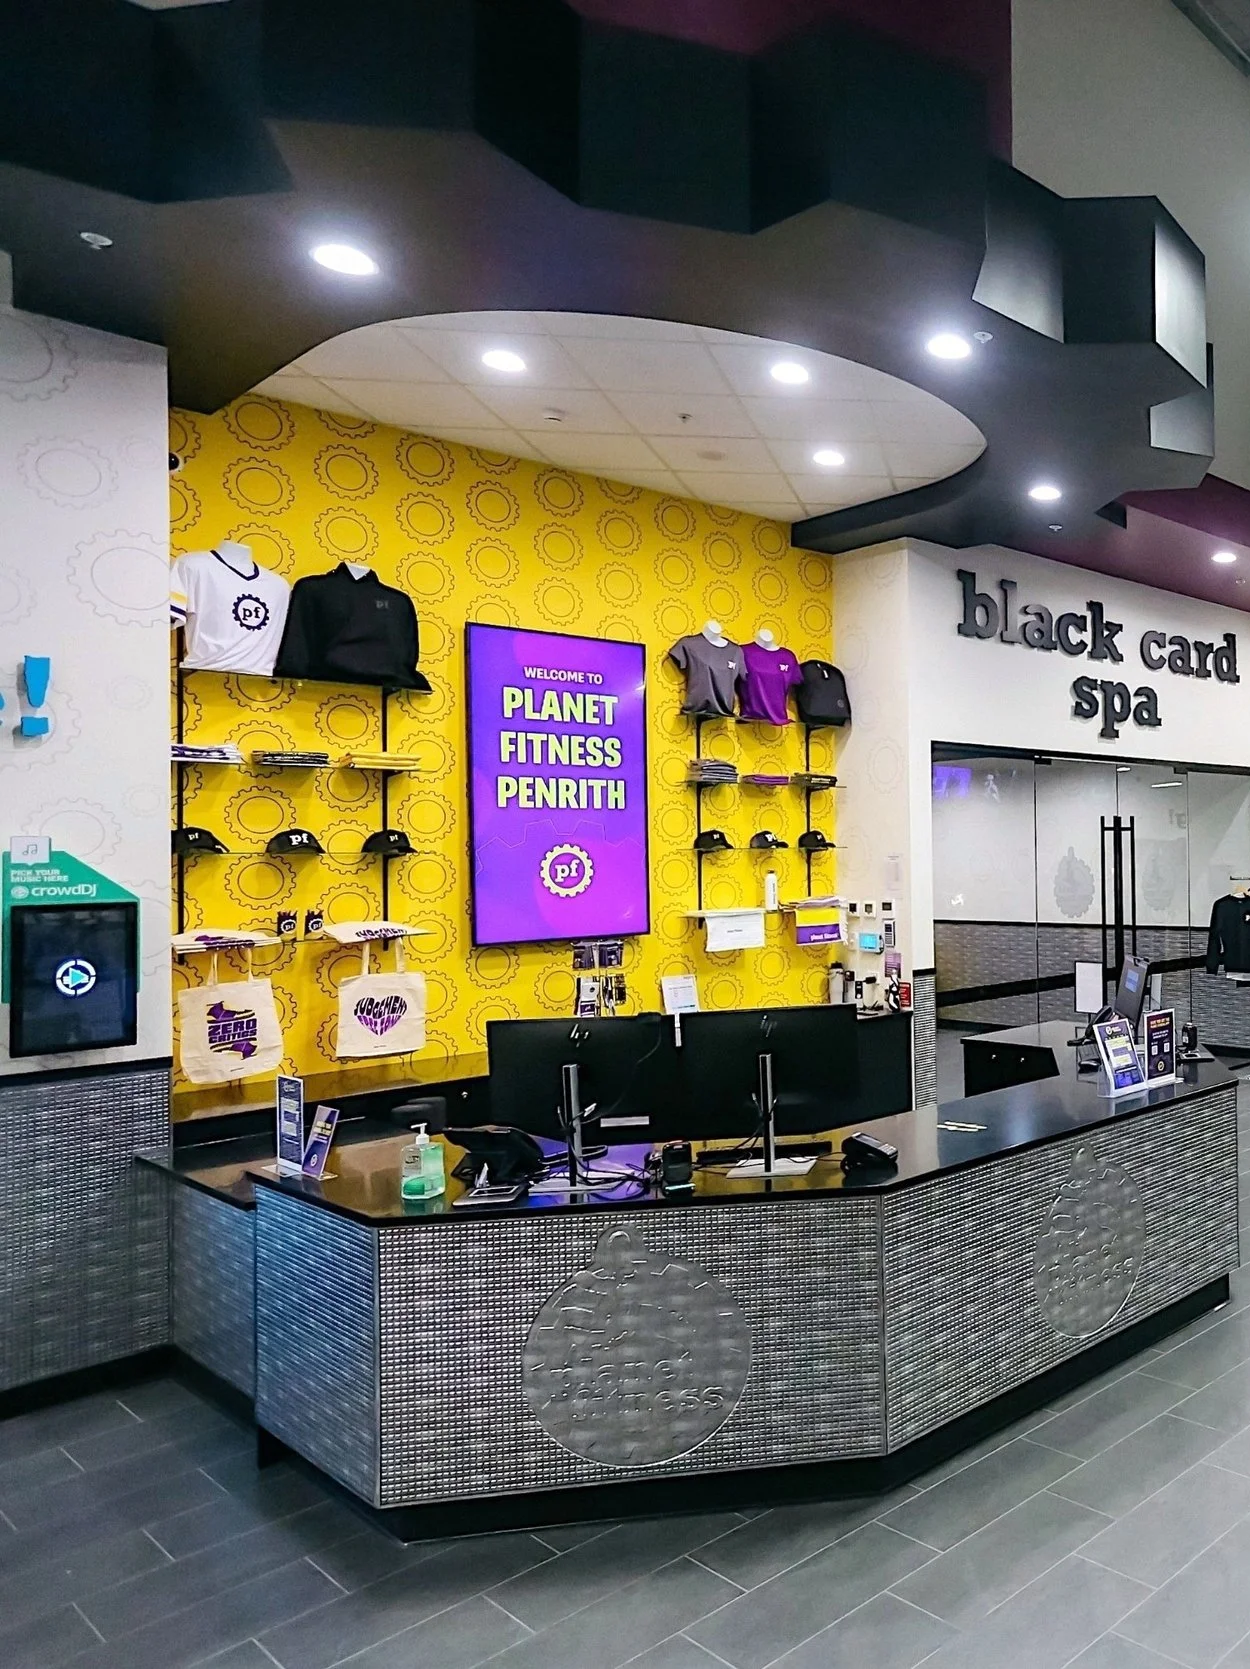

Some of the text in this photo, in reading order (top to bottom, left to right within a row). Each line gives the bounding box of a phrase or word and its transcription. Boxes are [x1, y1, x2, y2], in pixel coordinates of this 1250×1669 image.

[242, 607, 261, 621] pf
[957, 569, 1240, 683] black card
[524, 667, 603, 685] WELCOME TO
[503, 686, 619, 726] PLANET
[1072, 676, 1162, 738] spa
[500, 731, 622, 768] FITNESS
[497, 776, 626, 810] PENRITH
[188, 832, 199, 841] pf
[289, 833, 309, 846] pf
[11, 869, 34, 877] PICK
[555, 859, 580, 882] pf
[31, 884, 97, 897] crowdDJ
[208, 1018, 257, 1037] ZERO
[208, 1029, 257, 1043] CRITICS
